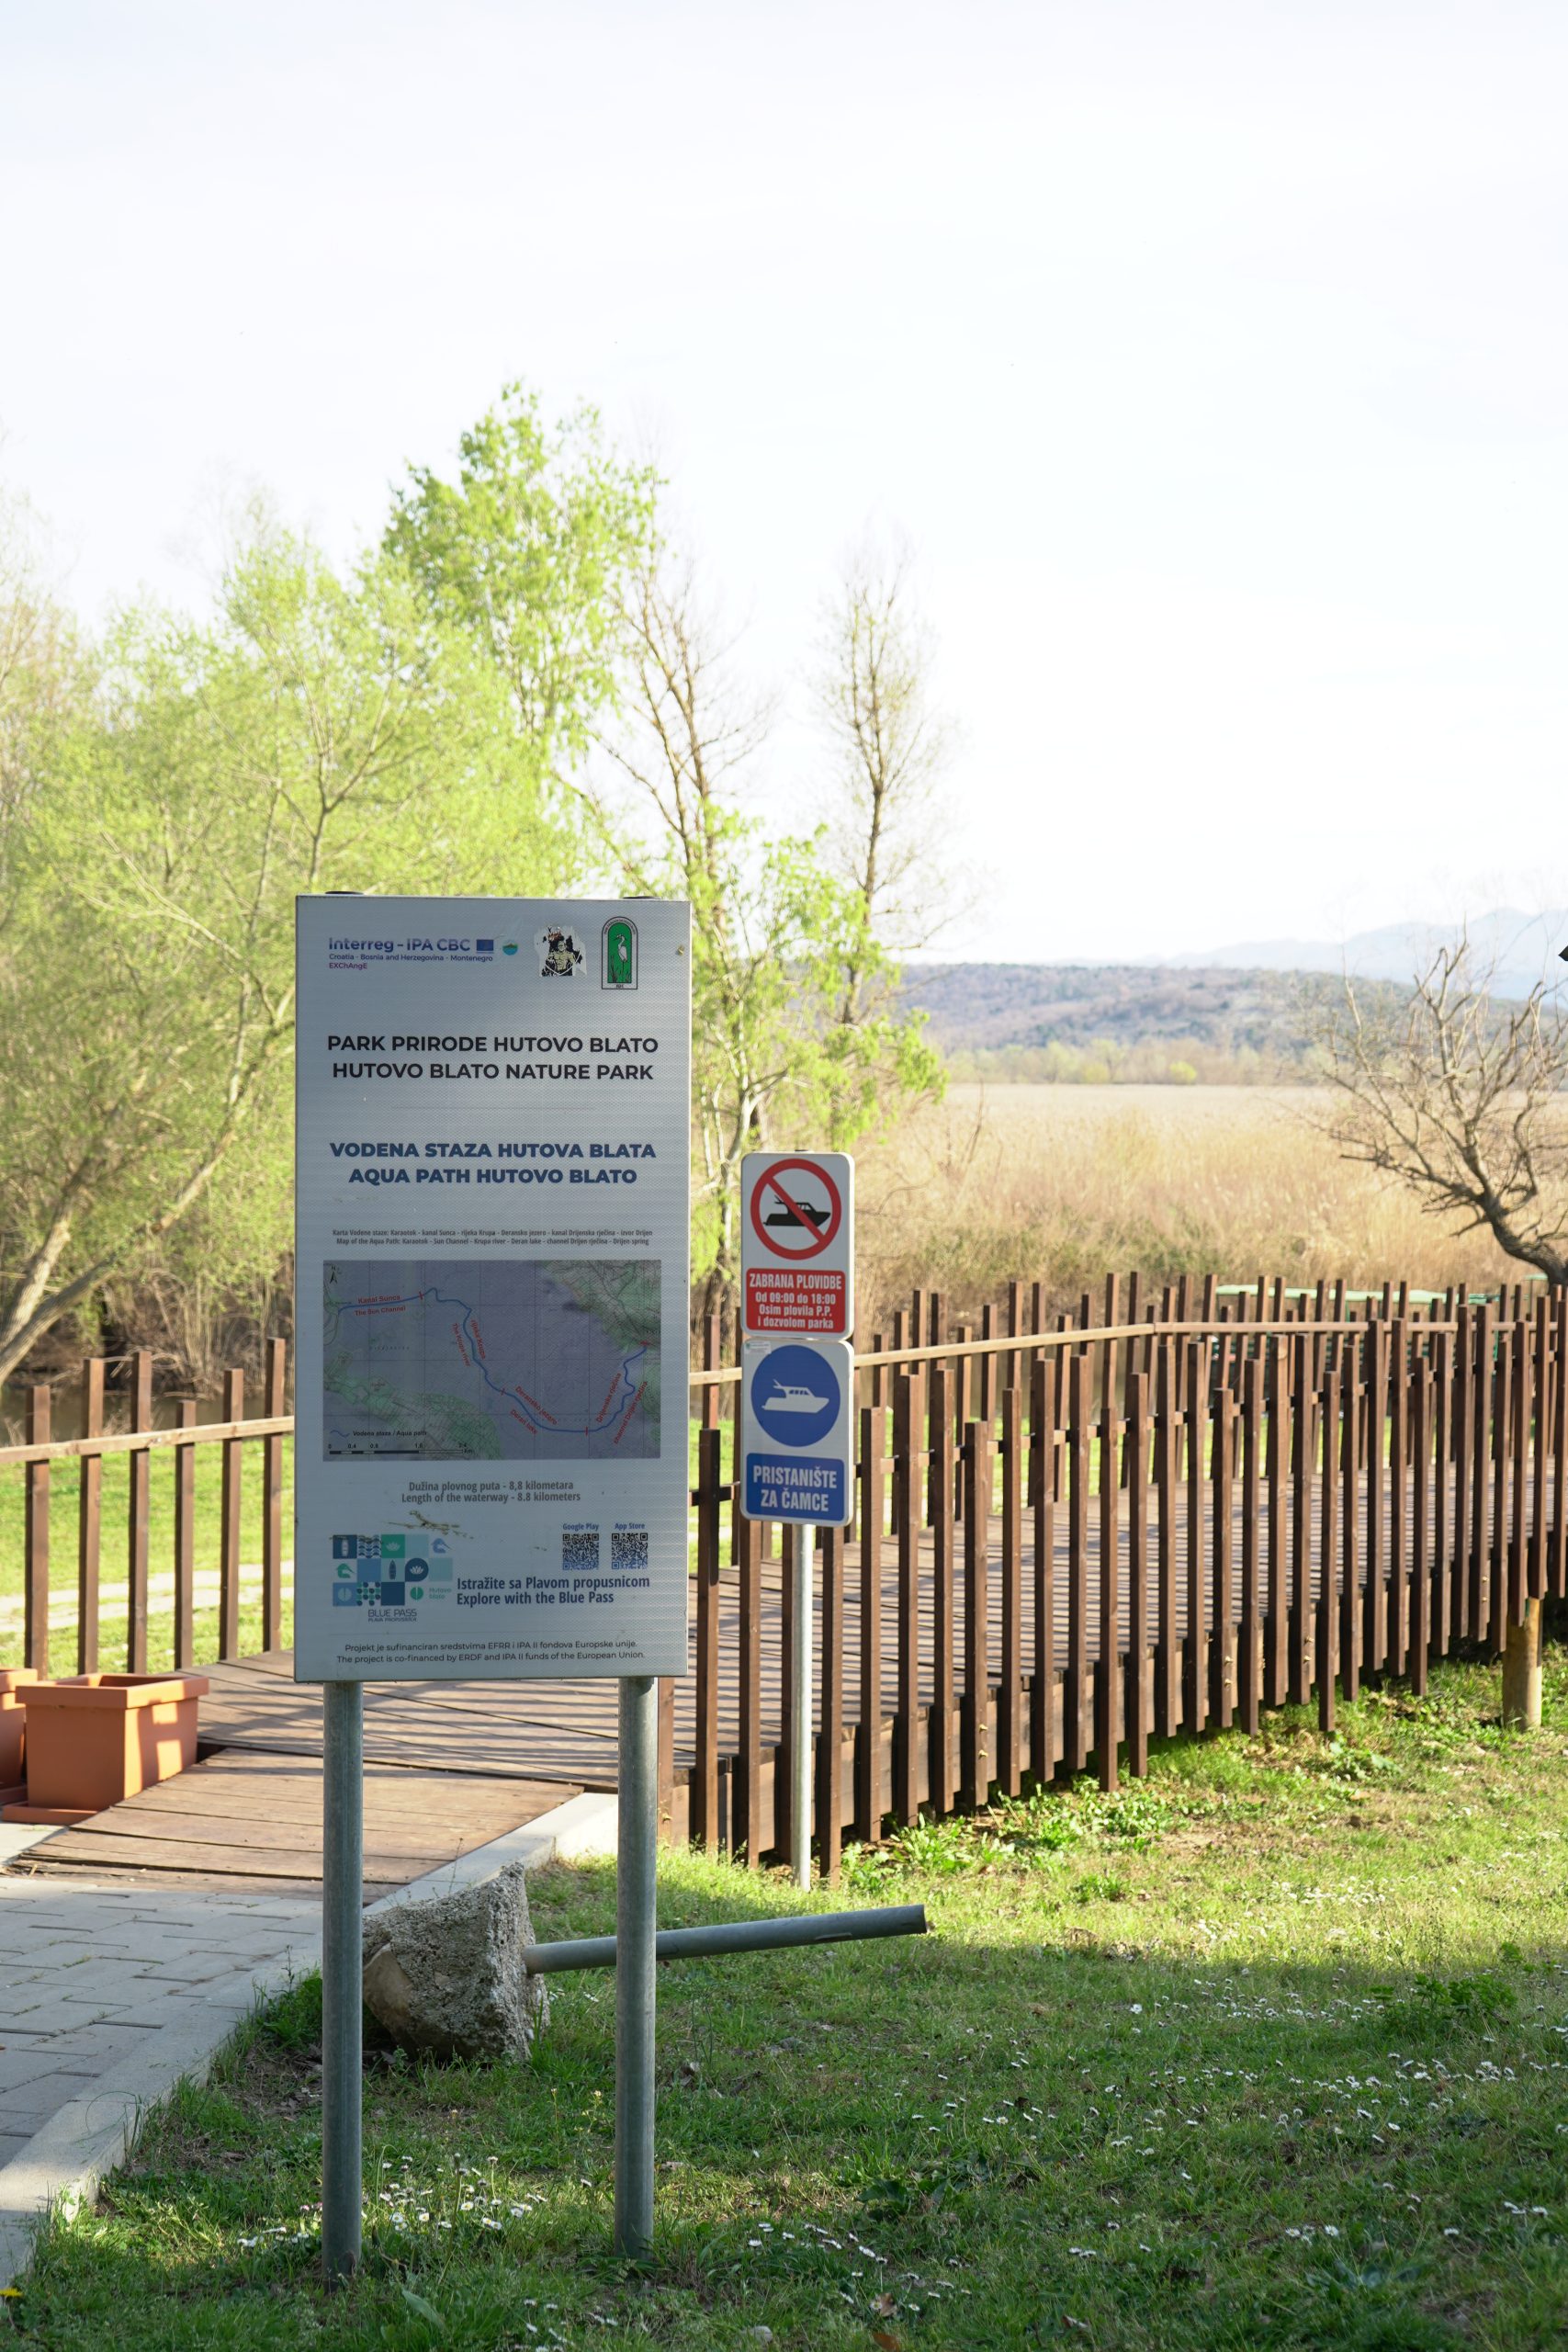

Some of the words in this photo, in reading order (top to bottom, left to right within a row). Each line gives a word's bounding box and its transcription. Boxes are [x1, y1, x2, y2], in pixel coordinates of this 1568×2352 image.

[329, 938, 393, 952] Interreg
[407, 939, 433, 951] IPA
[437, 939, 470, 951] CBC
[328, 1035, 385, 1051] PARK
[392, 1036, 487, 1052] PRIRODE
[494, 1037, 583, 1053] HUTOVO
[590, 1038, 659, 1053] BLATO
[333, 1063, 423, 1079] HUTOVO
[430, 1064, 500, 1079] BLATO
[506, 1065, 590, 1080] NATURE
[597, 1065, 654, 1080] PARK
[330, 1143, 419, 1158] VODENA
[425, 1143, 492, 1158] STAZA
[499, 1144, 583, 1158] HUTOVA
[590, 1144, 657, 1159] BLATA
[349, 1169, 410, 1186] AQUA
[416, 1169, 470, 1183] PATH
[477, 1170, 563, 1184] HUTOVO
[570, 1170, 637, 1184] BLATO
[750, 1273, 794, 1288] ZABRANA
[796, 1274, 841, 1290] PLOVIDBE
[755, 1292, 766, 1303] Od
[770, 1293, 795, 1303] 09:00
[797, 1294, 807, 1304] do
[812, 1294, 836, 1305] 18:00
[760, 1305, 781, 1315] Osim
[784, 1306, 813, 1317] plovila
[817, 1306, 832, 1317] P.P.
[758, 1316, 761, 1326] i
[763, 1316, 805, 1328] dozvolom
[808, 1318, 833, 1329] parka
[753, 1465, 837, 1488] PRISTANIŠTE
[409, 1481, 439, 1491] Dužina
[442, 1482, 478, 1493] plovnog
[480, 1483, 500, 1493] puta
[509, 1481, 523, 1491] 8,8
[525, 1481, 573, 1490] kilometara
[401, 1493, 432, 1504] Length
[434, 1493, 445, 1502] of
[446, 1493, 461, 1502] the
[464, 1494, 508, 1503] waterway
[517, 1492, 531, 1501] 8.8
[534, 1491, 581, 1501] kilometers
[761, 1489, 777, 1508] ZA
[782, 1487, 829, 1511] ČAMCE
[563, 1523, 584, 1532] Google
[586, 1523, 599, 1532] Play
[615, 1523, 627, 1532] App
[457, 1577, 504, 1589] Istražite
[509, 1580, 522, 1589] sa
[526, 1577, 569, 1589] Plavom
[573, 1576, 649, 1591] propusnicom
[457, 1593, 500, 1607] Explore
[505, 1592, 531, 1603] with
[536, 1592, 555, 1603] the
[559, 1591, 584, 1603] Blue
[589, 1592, 614, 1603] Pass
[575, 1641, 613, 1649] Europske
[355, 1656, 384, 1664] project
